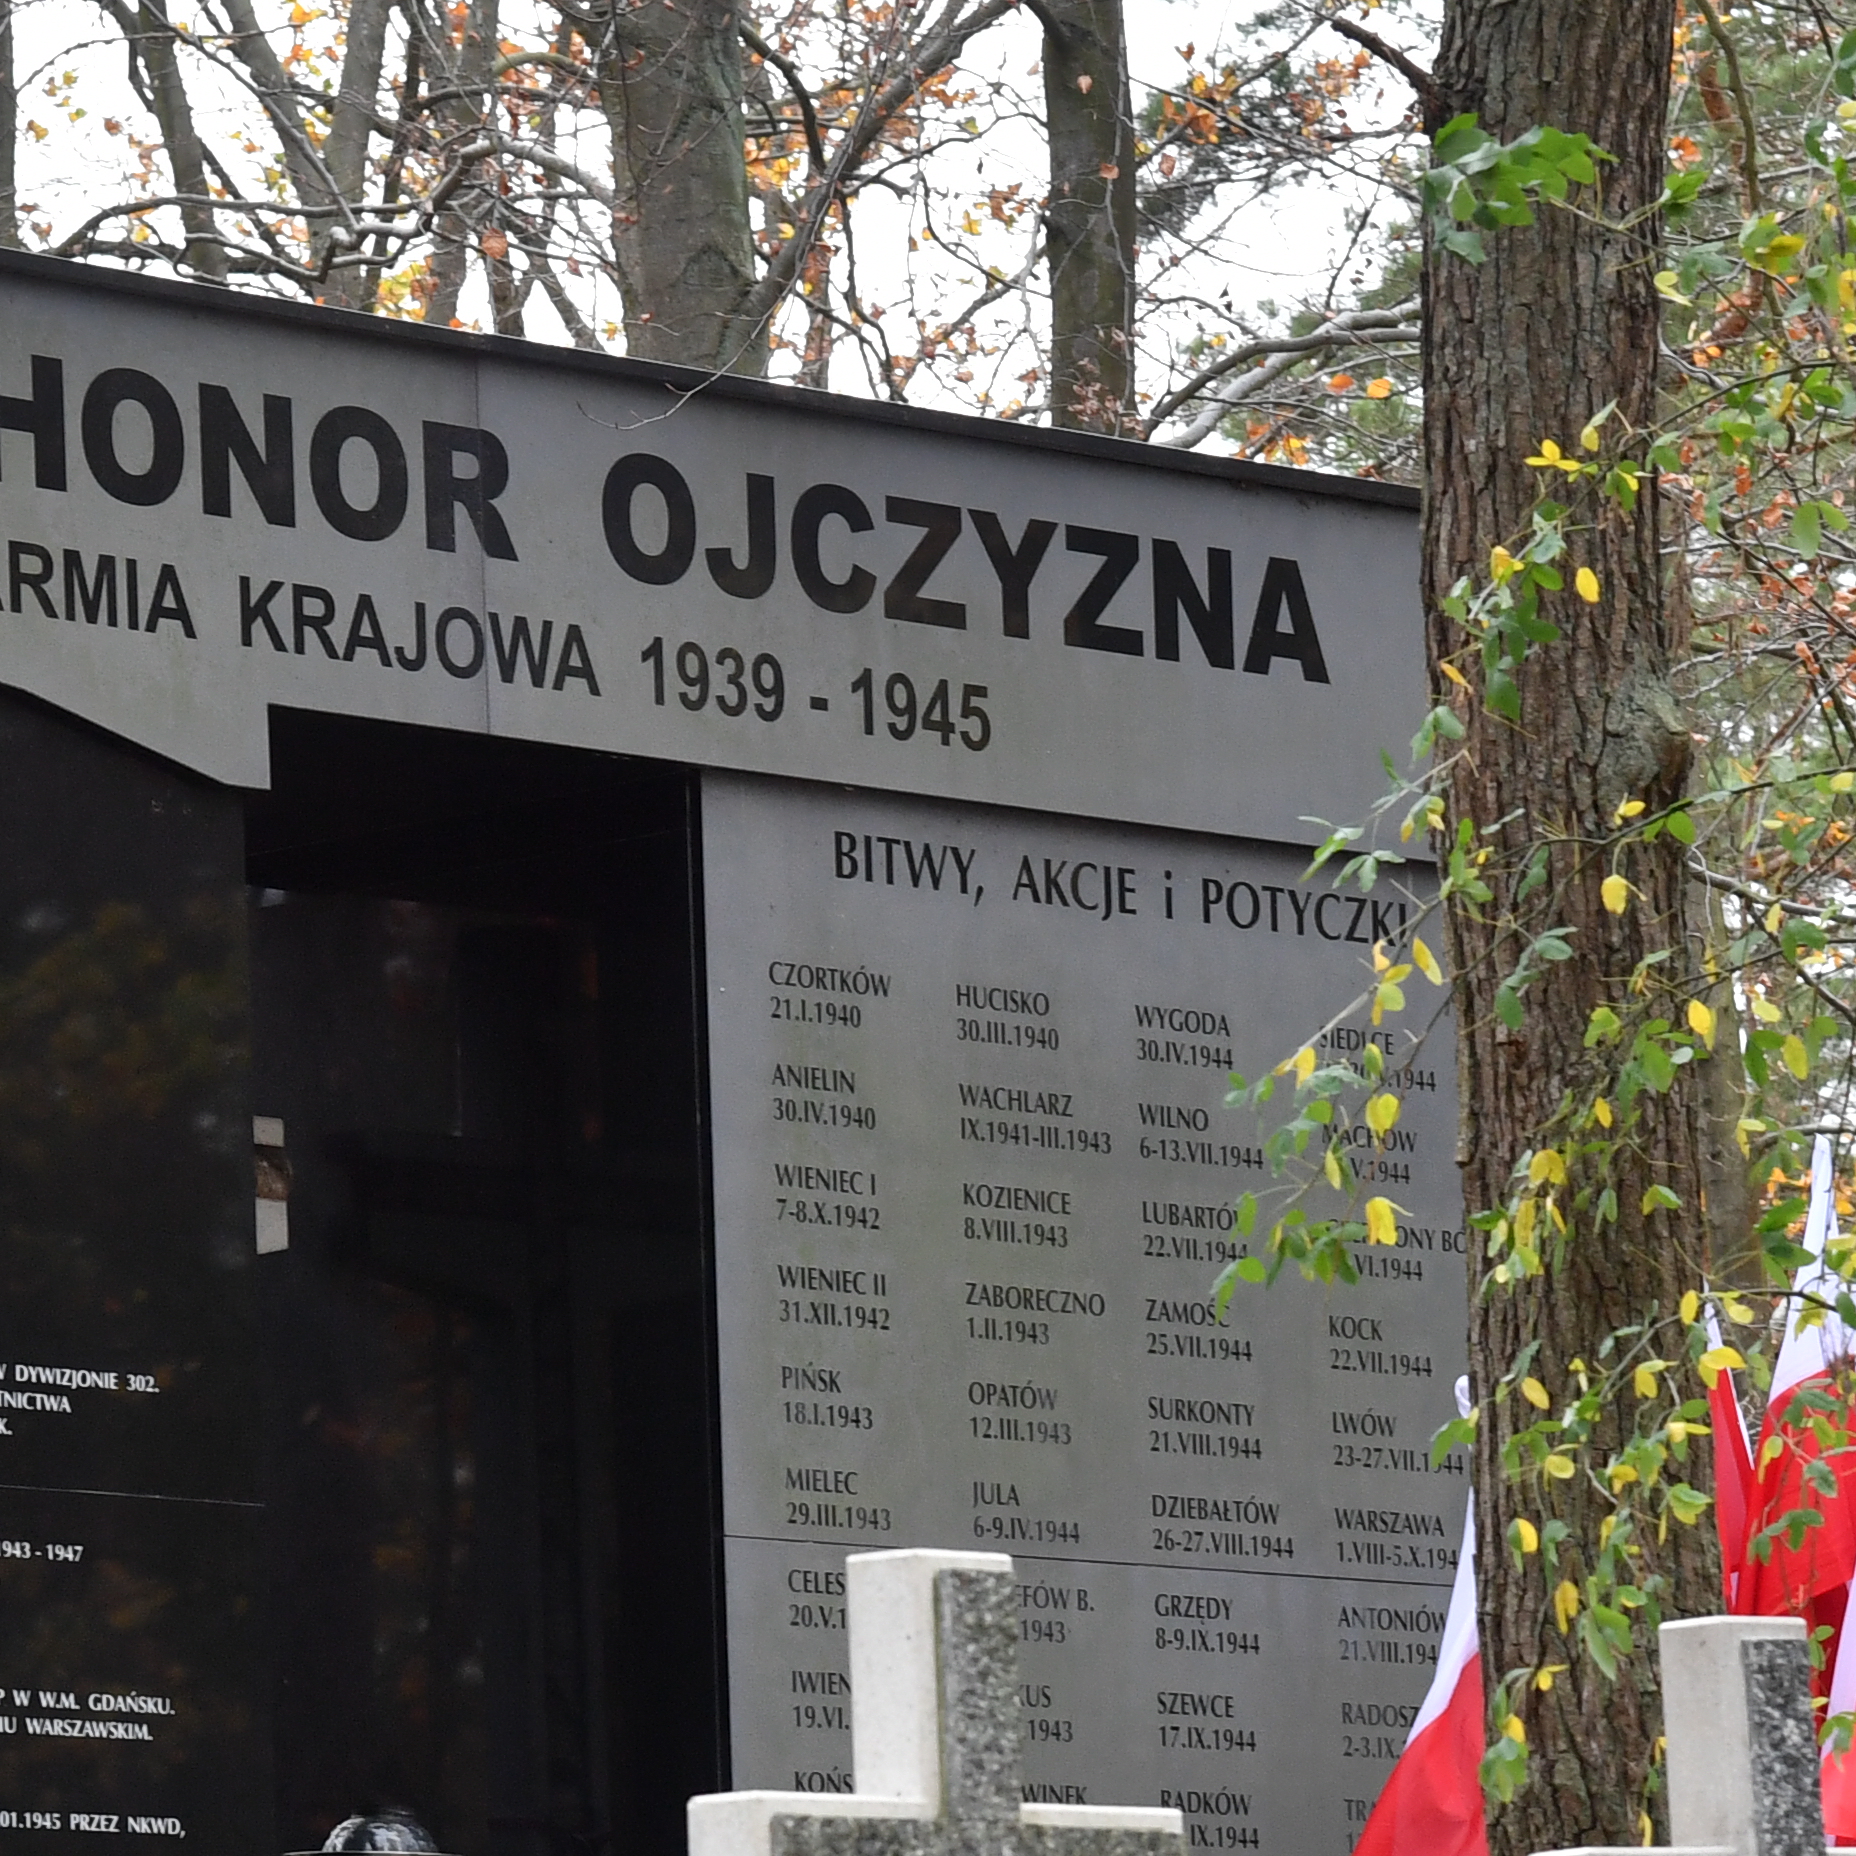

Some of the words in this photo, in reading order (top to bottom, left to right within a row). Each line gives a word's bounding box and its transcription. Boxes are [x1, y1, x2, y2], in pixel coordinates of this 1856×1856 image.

[602, 452, 1330, 685] OJCZYZNA
[239, 575, 601, 697] KRAJOWA
[642, 636, 784, 723] 1939
[851, 667, 991, 752] 1945
[834, 830, 983, 907] BITWY,
[1013, 854, 1136, 922] AKCJE
[1202, 878, 1407, 949] POTYCZKI
[769, 961, 890, 998] CZORTKÓW
[771, 996, 861, 1028] 21.I.1940
[956, 984, 1049, 1016] HUCISKO
[957, 1018, 1059, 1050] 30.III.1940
[1135, 1005, 1230, 1037] WYGODA
[1137, 1038, 1233, 1070] 30.IV.1944
[773, 1063, 854, 1094] ANIELIN
[774, 1097, 875, 1130] 30.IV.1940
[959, 1083, 1073, 1117] WACHLARZ
[1139, 1103, 1208, 1132] WILNO
[961, 1117, 1111, 1154] IX.1941-III.1943
[1140, 1136, 1263, 1170] 6-13.VII.1944
[775, 1163, 863, 1196] WIENIEC
[777, 1198, 880, 1230] 7-8.X.1942
[963, 1183, 1071, 1215] KOZIENICE
[965, 1217, 1067, 1249] 8.VIII.1943
[778, 1264, 866, 1295] WIENIEC
[874, 1273, 885, 1296] II
[780, 1299, 889, 1330] 31.XII.1942
[966, 1283, 1105, 1317] ZABORECZNO
[967, 1317, 1049, 1345] 1.II.1943
[1329, 1315, 1382, 1341] KOCK
[1147, 1332, 1252, 1362] 25.VII.1944
[782, 1362, 841, 1393] PIŃSK
[1330, 1348, 1432, 1378] 22.VII.1944
[969, 1379, 1054, 1411] OPATÓW
[784, 1402, 872, 1430] 18.I.1943
[1149, 1396, 1254, 1427] SURKONTY
[1333, 1408, 1396, 1437] LWÓW
[970, 1416, 1071, 1445] 12.III.1943
[1150, 1430, 1261, 1460] 21.VIII.1944
[786, 1467, 857, 1496] MIELEC
[974, 1481, 1020, 1508] JULA
[787, 1502, 890, 1531] 29.III.1943
[1152, 1494, 1279, 1525] DZIEBAŁTÓW
[1335, 1507, 1444, 1538] WARSZAWA
[974, 1515, 1079, 1543] 6-9.IV.1944
[1153, 1529, 1294, 1559] 26-27.VIII.1944
[1155, 1593, 1229, 1625] GRZĘDY
[1156, 1627, 1260, 1655] 8-9.IX.1944
[1158, 1691, 1234, 1719] SZEWCE
[1160, 1725, 1256, 1753] 17.IX.1944
